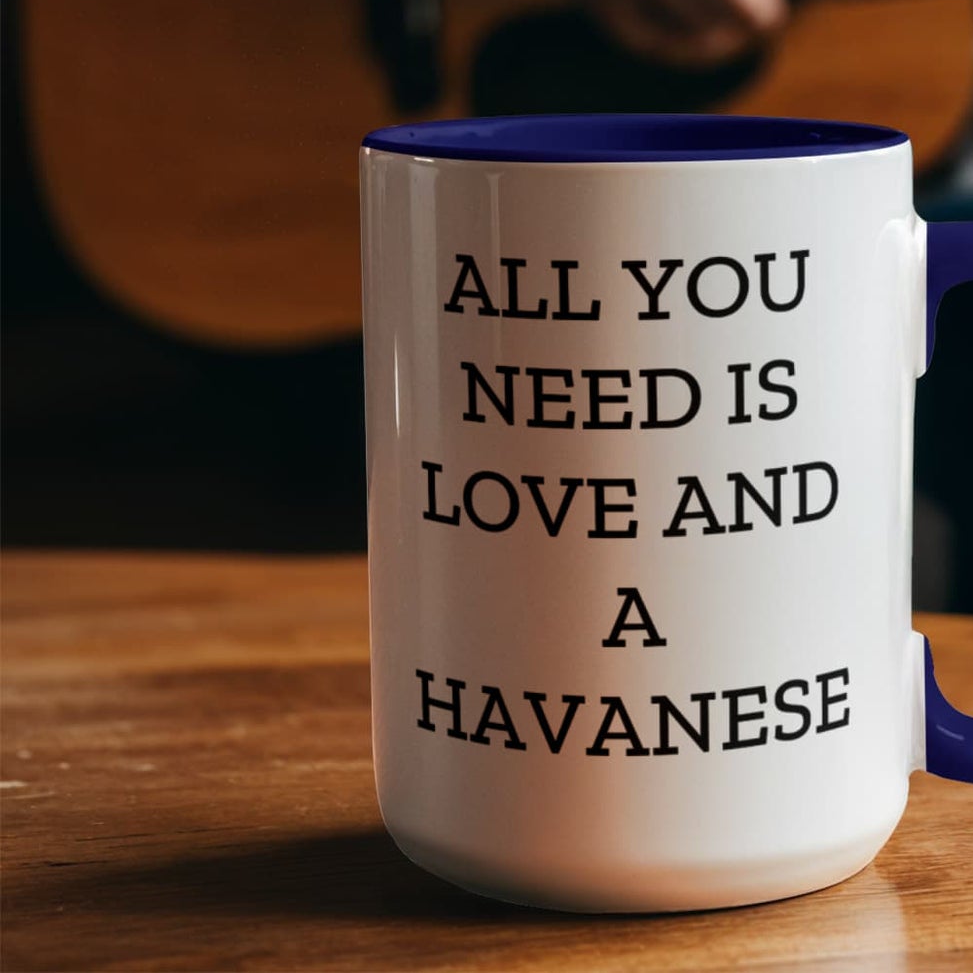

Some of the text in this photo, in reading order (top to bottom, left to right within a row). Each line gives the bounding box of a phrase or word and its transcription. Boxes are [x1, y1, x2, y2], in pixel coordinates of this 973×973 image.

[444, 250, 810, 322] ALL YOU
[461, 359, 798, 430] NEED IS
[421, 461, 839, 539] LOVE AND
[602, 587, 667, 647] A
[416, 668, 850, 757] HAVANESE
